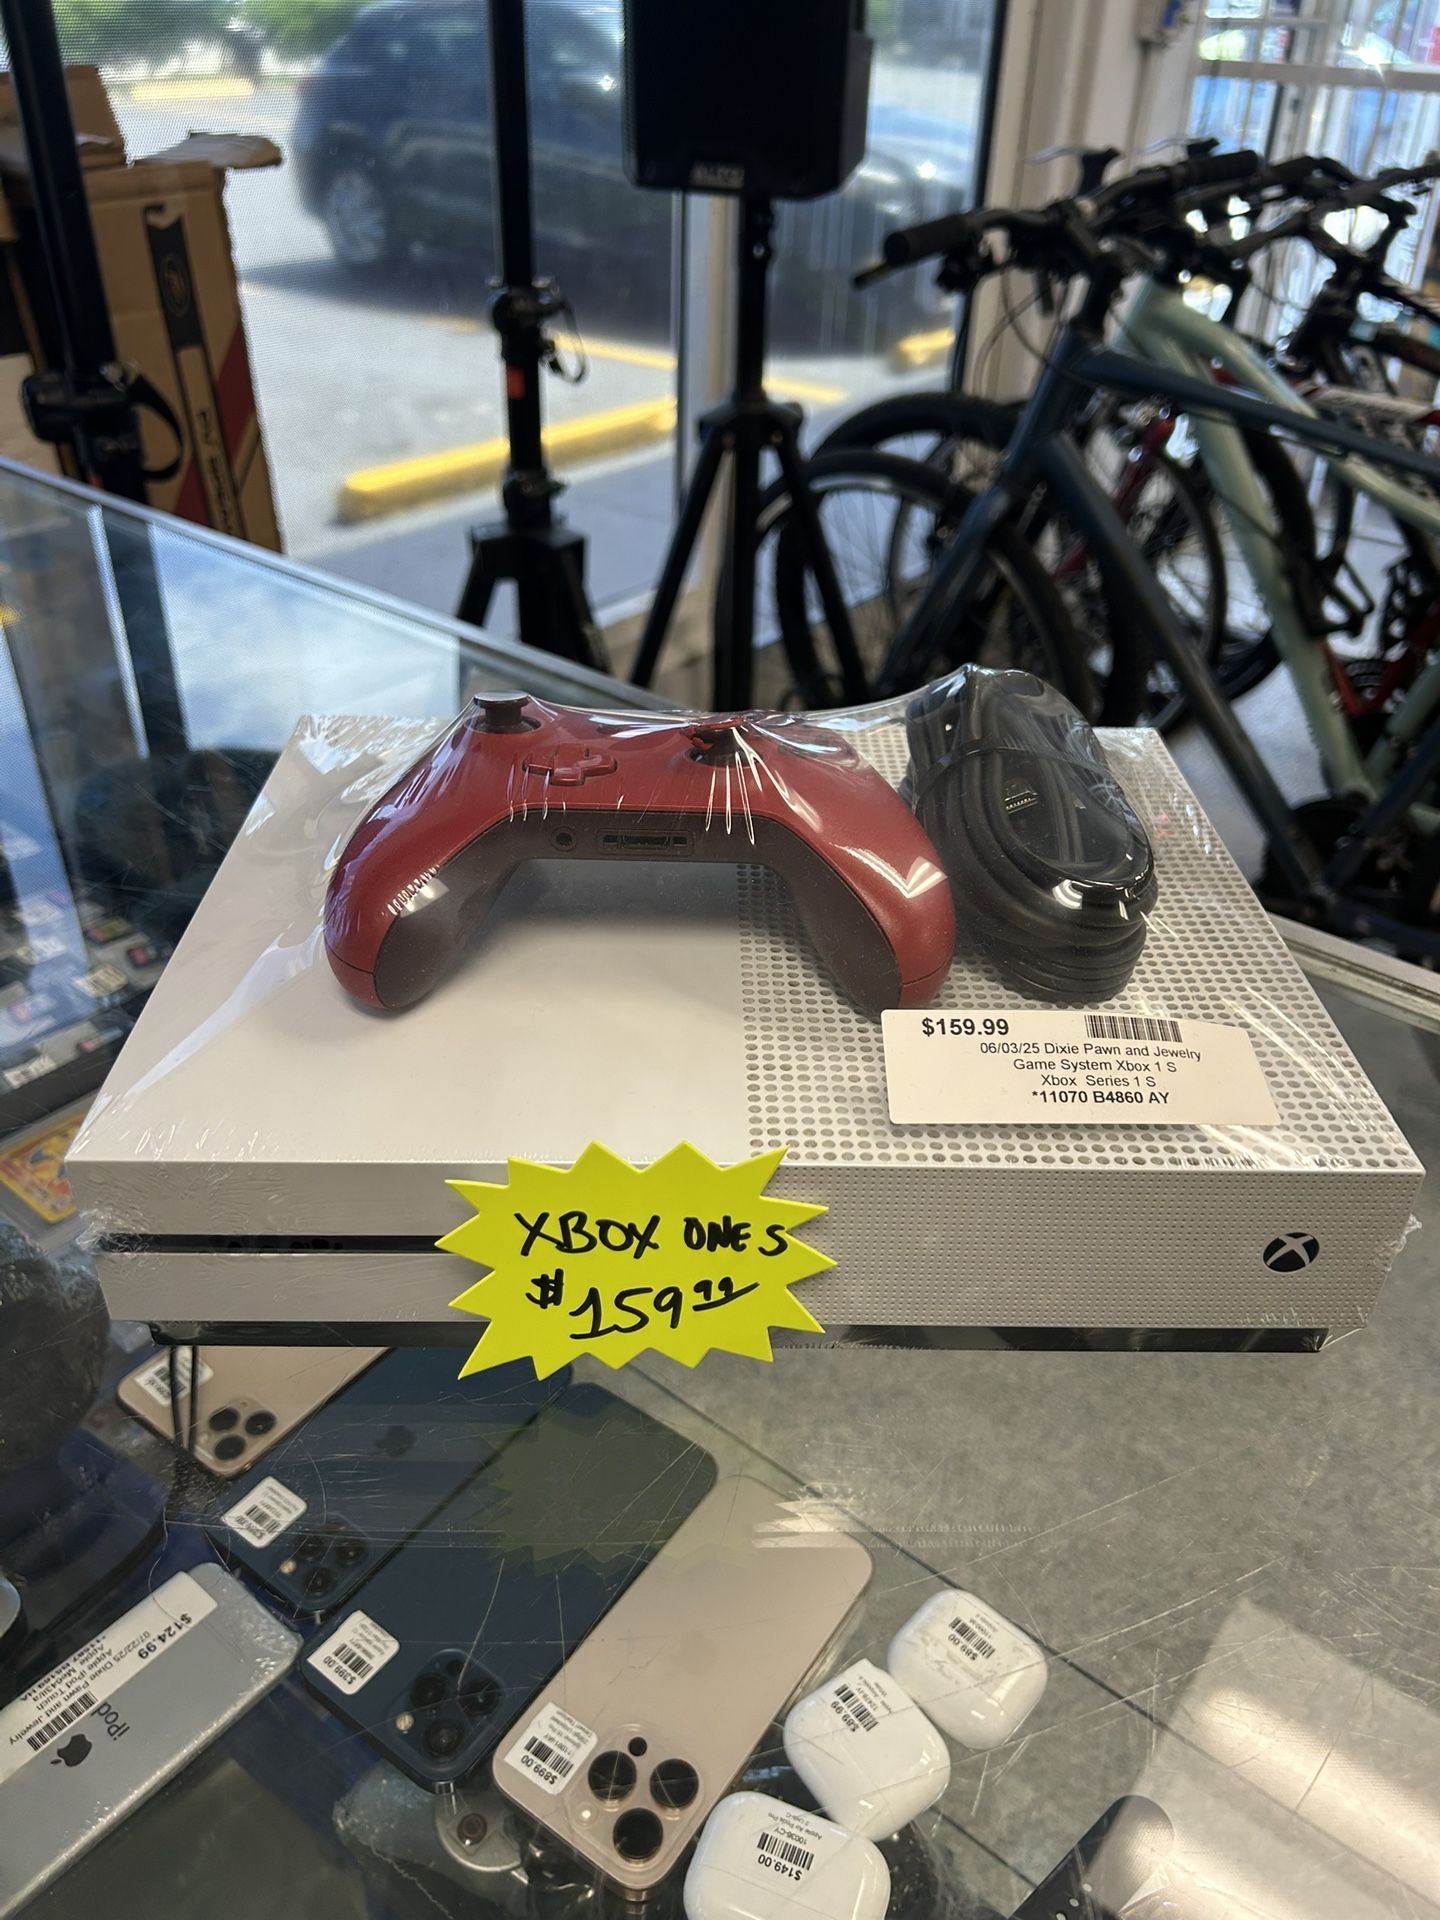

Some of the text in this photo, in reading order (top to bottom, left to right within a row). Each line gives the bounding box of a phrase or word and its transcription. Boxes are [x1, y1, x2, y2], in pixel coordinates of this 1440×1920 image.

[921, 1016, 1010, 1037] $159.99
[979, 1042, 1201, 1062] 06/03/25 Dixie Pawn and Jewelry
[1013, 1058, 1178, 1073] Game System Xbox 1 S
[1040, 1074, 1157, 1088] Xbox Series 1 S
[1093, 1091, 1144, 1104] B4860
[1148, 1091, 1170, 1104] AY
[513, 1210, 789, 1259] XBOX ONE S
[138, 1613, 193, 1660] $124.99
[947, 1633, 978, 1661] $89.00
[87, 1647, 112, 1670] Apple
[89, 1660, 114, 1681] Dixie
[36, 1688, 66, 1711] Touch
[63, 1680, 90, 1702] Pawn
[45, 1701, 62, 1718] and
[91, 1700, 130, 1741] iPod
[830, 1700, 859, 1732] $89.99
[9, 1715, 43, 1745] Jewelry
[520, 1754, 558, 1785] $899.00
[757, 1853, 803, 1881] $149.00
